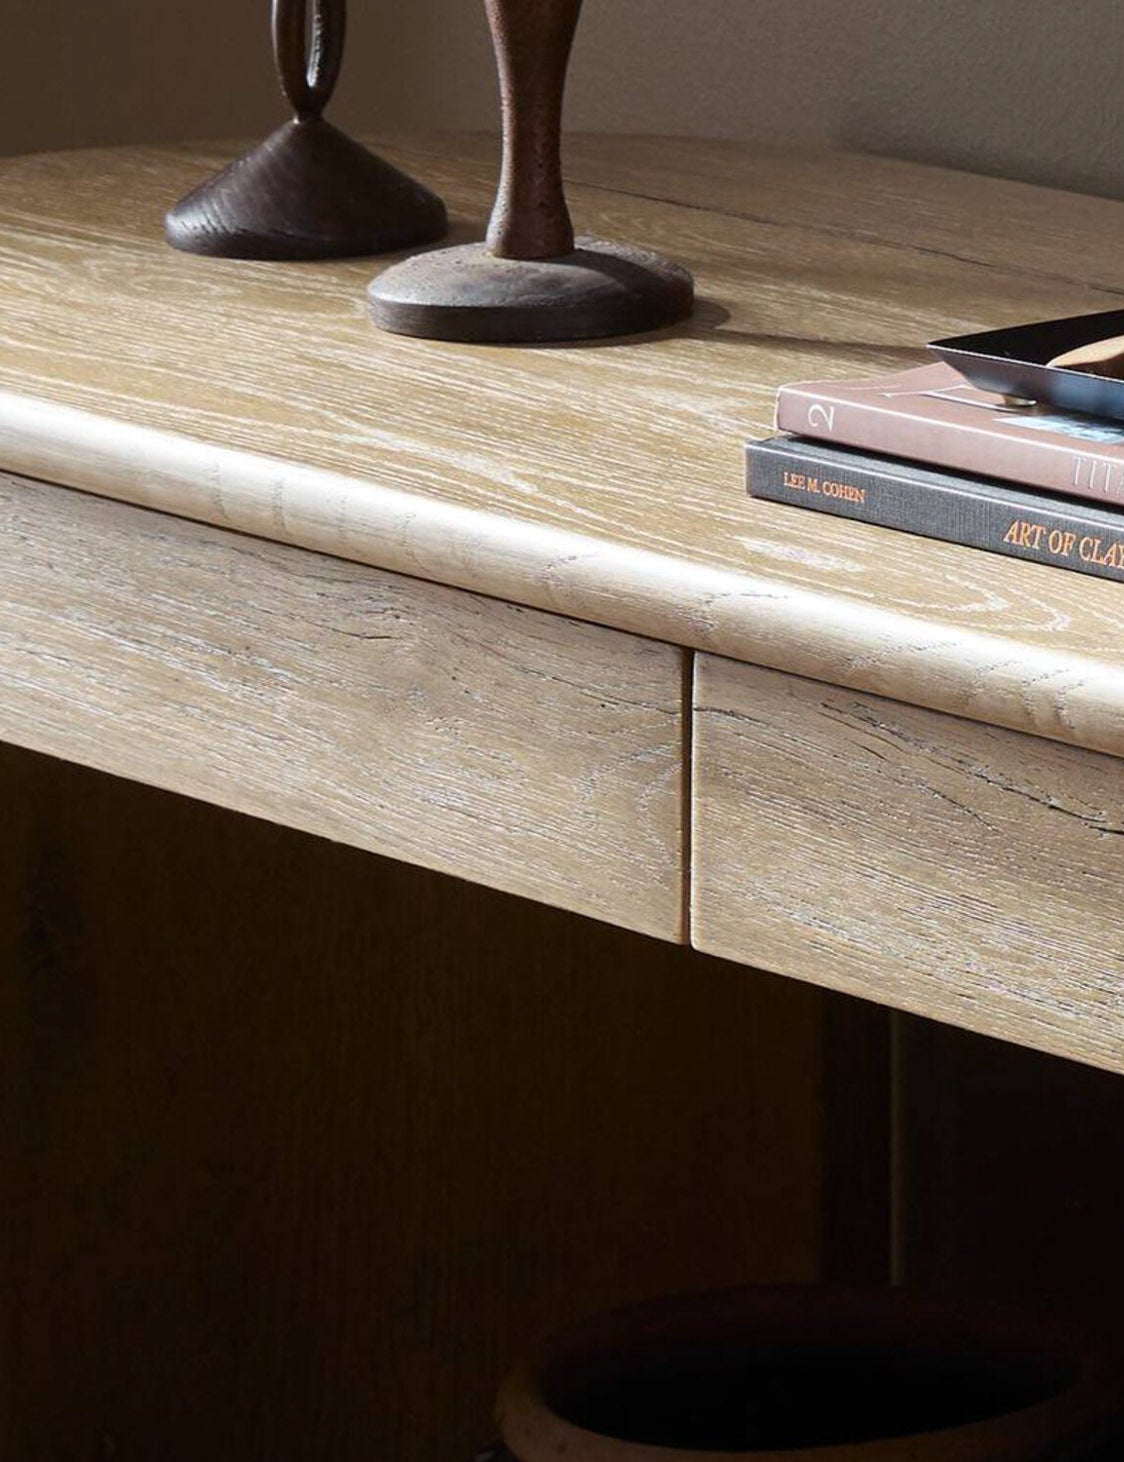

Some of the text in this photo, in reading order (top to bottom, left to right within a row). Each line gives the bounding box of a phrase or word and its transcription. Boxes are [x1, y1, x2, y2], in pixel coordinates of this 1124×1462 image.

[807, 404, 835, 431] 2
[783, 471, 806, 490] LEE
[822, 480, 866, 504] COHEN
[1002, 519, 1046, 550] ART
[1048, 529, 1077, 557] OF
